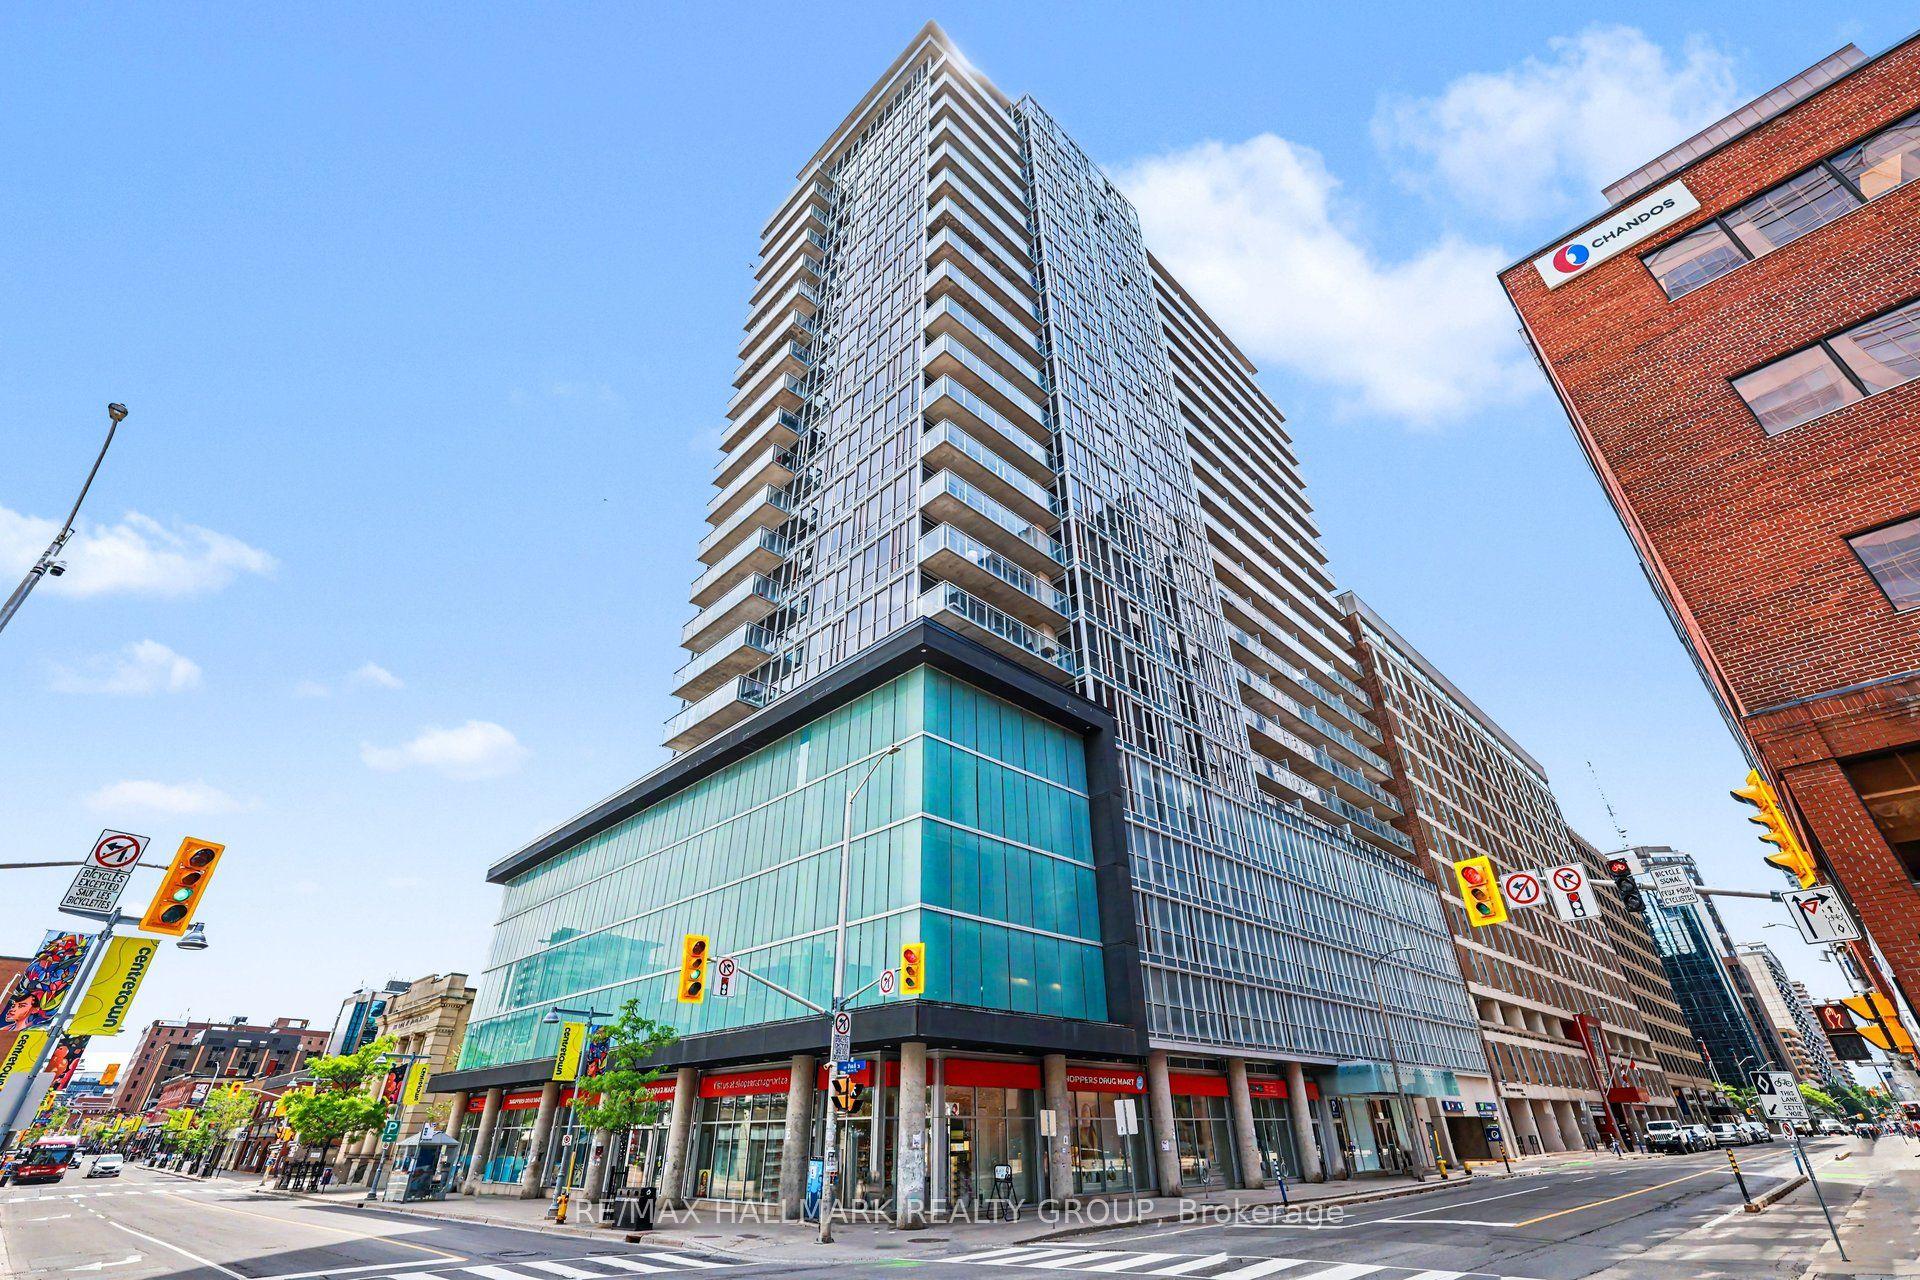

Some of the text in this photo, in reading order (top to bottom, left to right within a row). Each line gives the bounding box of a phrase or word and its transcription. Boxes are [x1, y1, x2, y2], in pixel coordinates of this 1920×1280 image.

[1591, 198, 1675, 248] CHANDOS
[82, 869, 125, 883] BICYCLES
[1655, 868, 1680, 878] BICYCLE
[77, 877, 119, 891] EXCEPTED
[1660, 876, 1682, 885] SIGNAL
[76, 888, 112, 900] SAUF LES
[1664, 894, 1695, 904] CYCLISTES
[66, 895, 112, 909] BICYCLETTES
[103, 947, 152, 1028] centretown
[1117, 1078, 1135, 1086] MART
[387, 1122, 398, 1133] P
